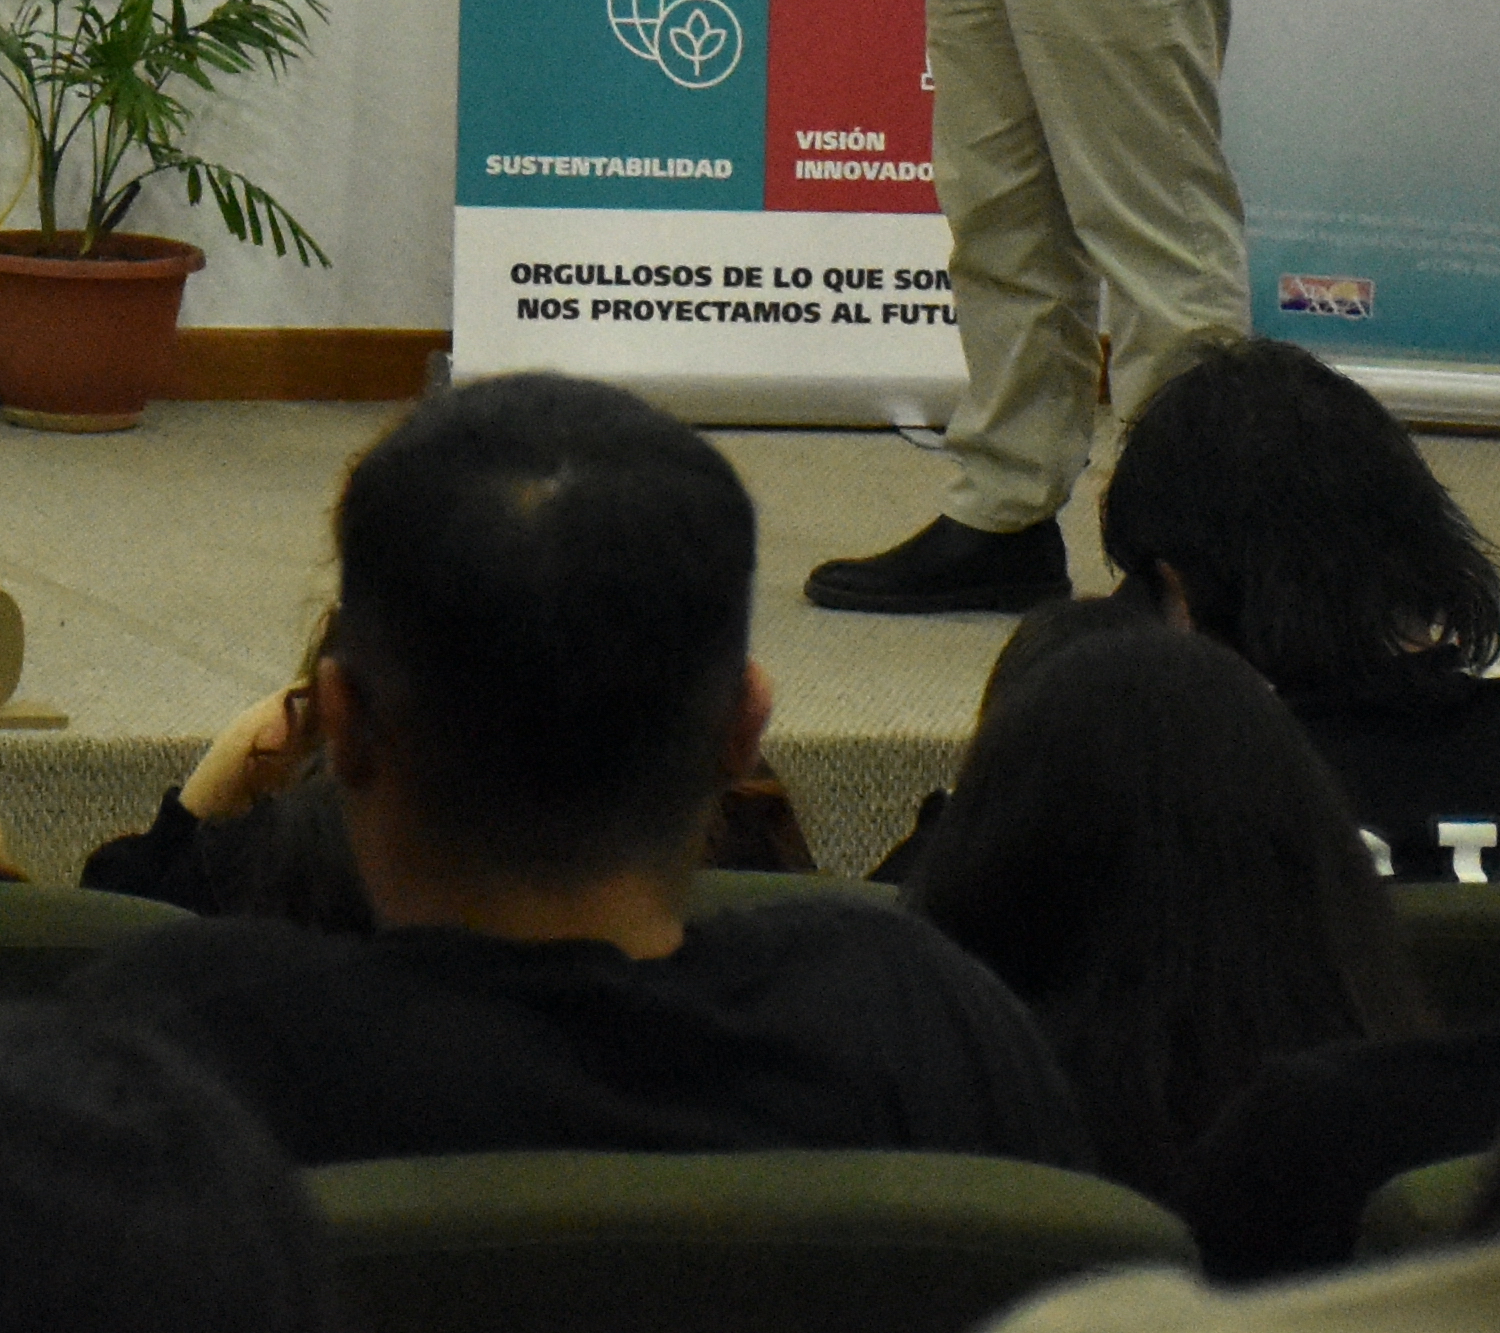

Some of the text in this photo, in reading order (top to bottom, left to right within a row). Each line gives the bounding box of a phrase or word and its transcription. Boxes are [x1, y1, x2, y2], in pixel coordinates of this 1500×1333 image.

[795, 125, 886, 152] VISIÓN
[485, 154, 733, 179] SUSTENTABILIDAD
[795, 159, 936, 183] INNOVADO
[510, 262, 952, 294] ORGULLOSOS DE LO QUE SOM
[516, 297, 958, 326] NOS PROYECTAMOS AL FUTU
